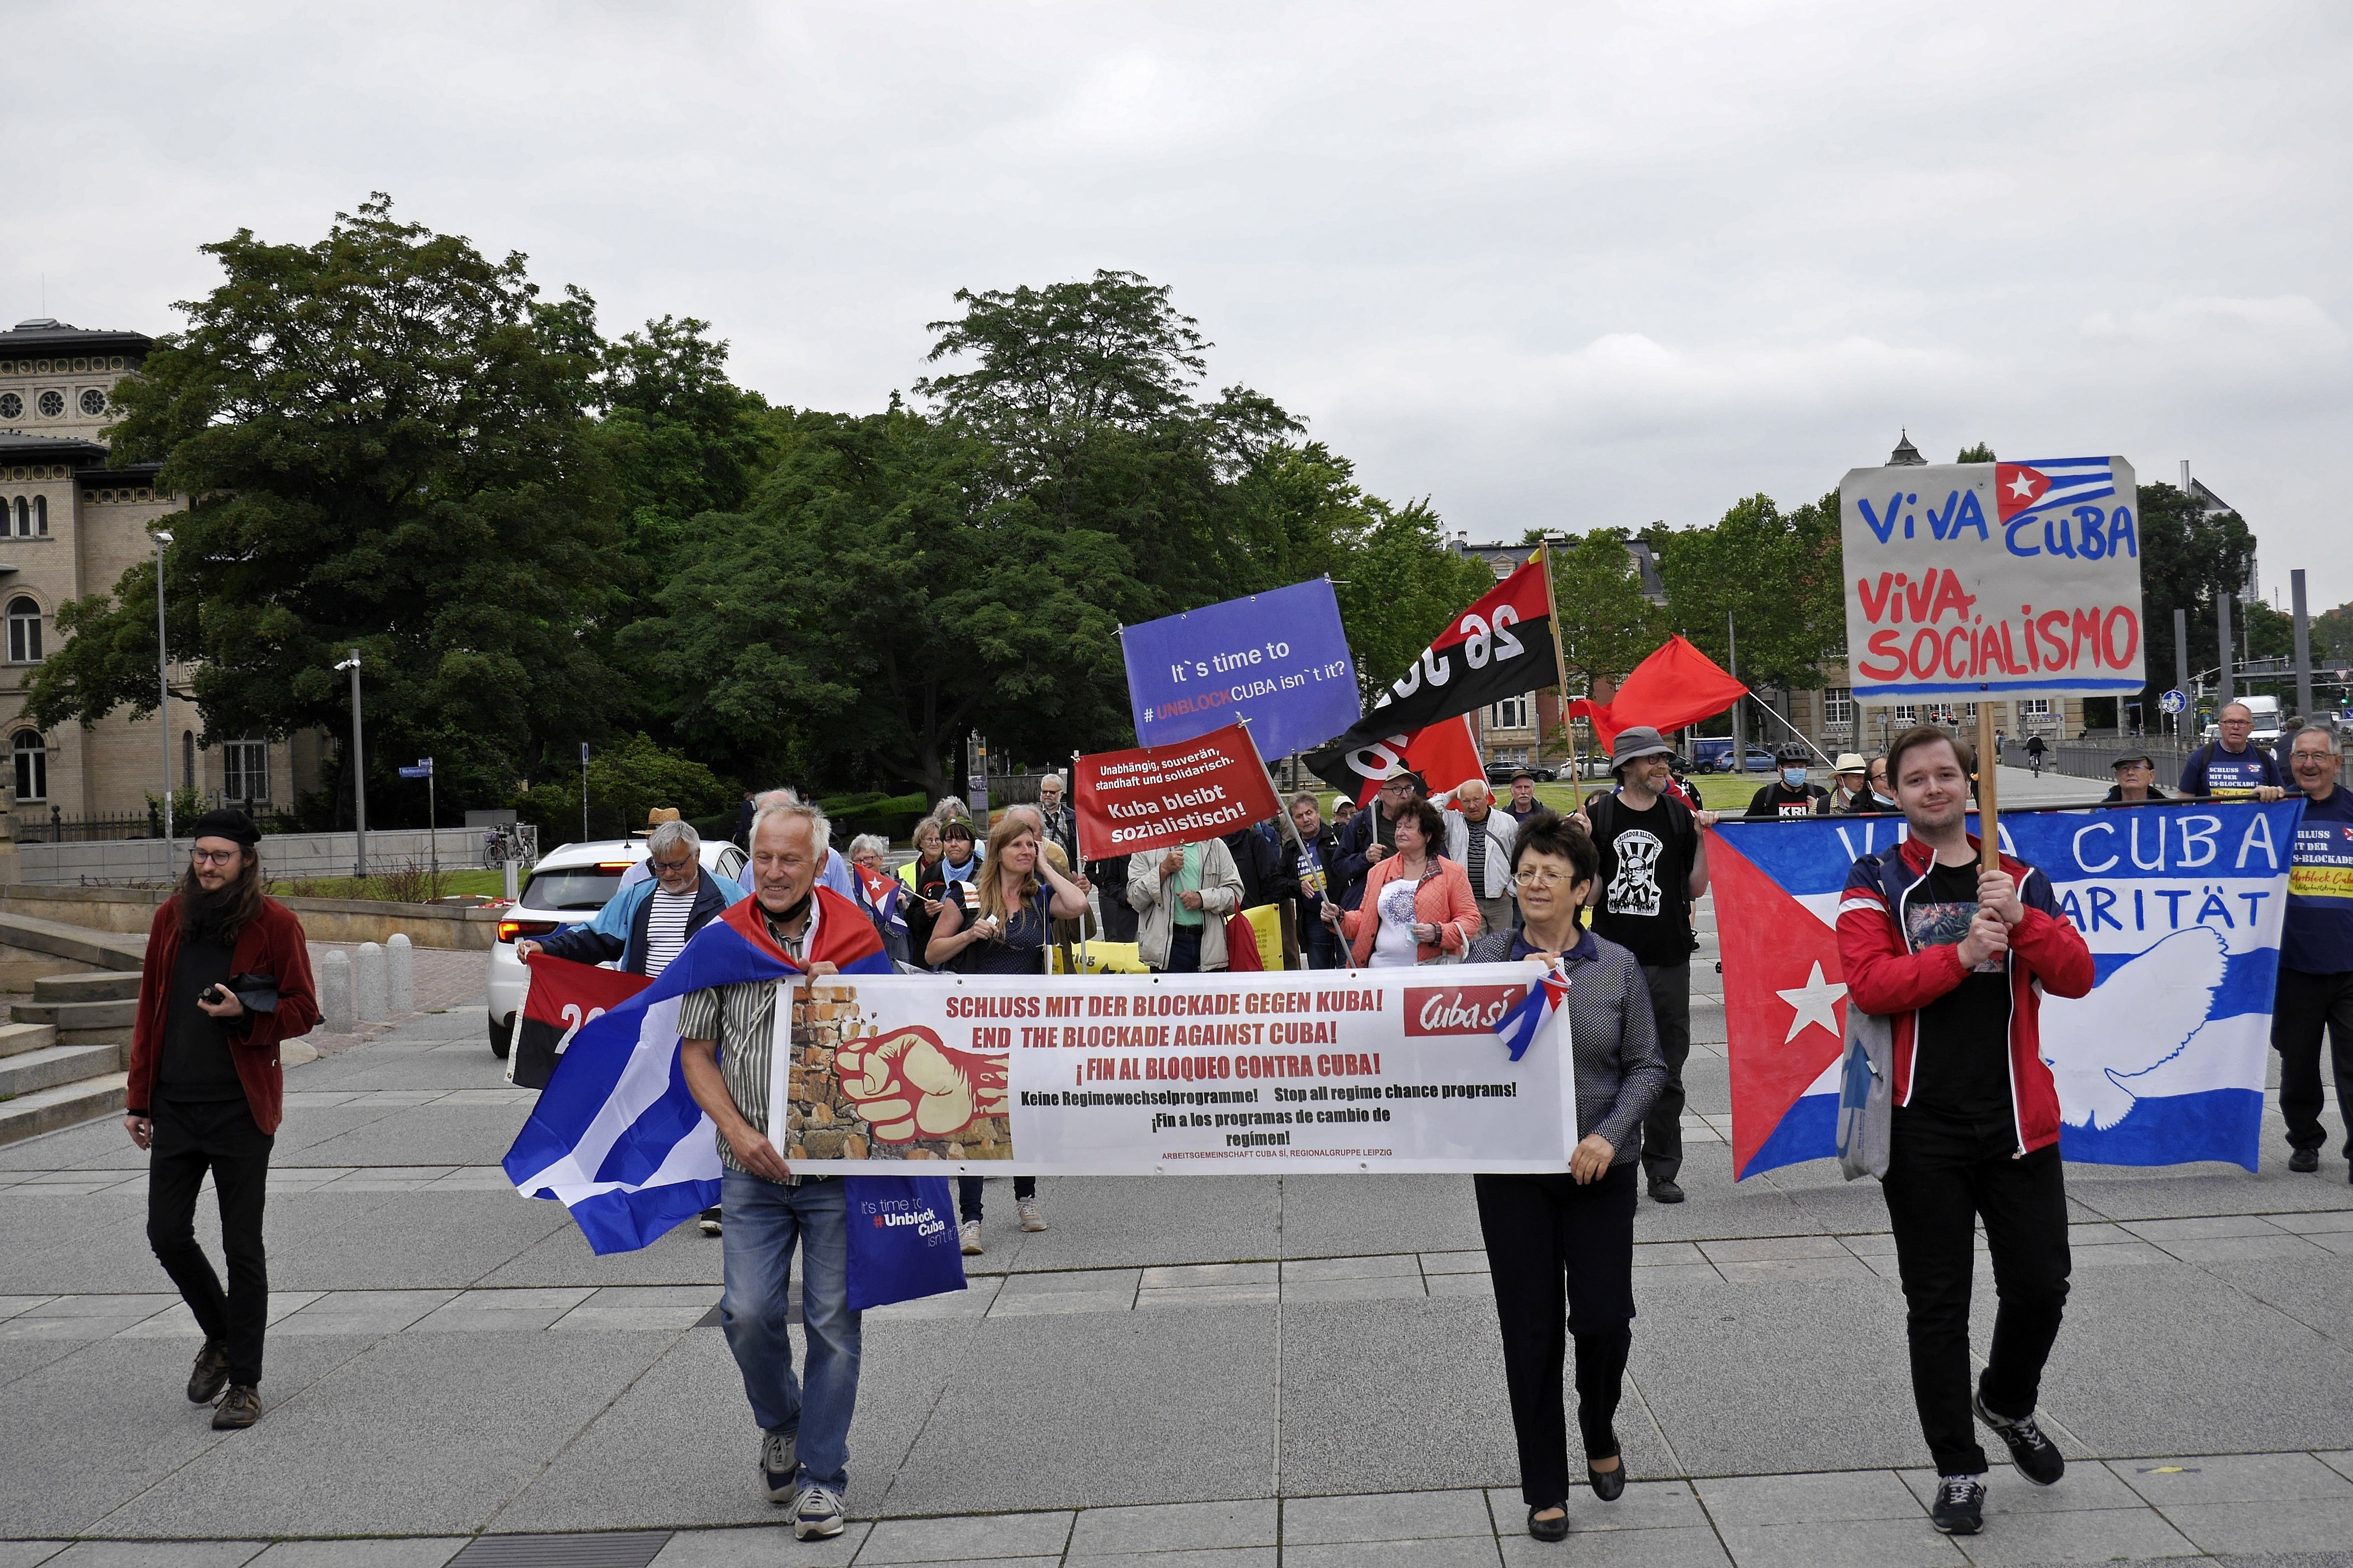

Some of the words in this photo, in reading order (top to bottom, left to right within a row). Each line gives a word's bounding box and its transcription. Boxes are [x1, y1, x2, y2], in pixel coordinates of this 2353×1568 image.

[1212, 648, 1263, 675] time
[1266, 641, 1290, 661] to
[1324, 660, 1345, 679] it?
[1095, 773, 1140, 792] standhaft
[1143, 770, 1163, 785] und
[1165, 756, 1235, 783] solidarisch.
[1099, 759, 1160, 778] Unabhängig,
[1162, 746, 1220, 771] souverän,
[1107, 794, 1158, 820] Kuba
[1162, 783, 1227, 812] bleibt
[1110, 801, 1247, 844] sozialistisch!
[2073, 813, 2278, 872] CUBA
[946, 996, 1040, 1018] SCHLUSS
[1045, 995, 1083, 1018] MIT
[1088, 994, 1128, 1017] DER
[1133, 993, 1240, 1017] BLOCKADE
[1245, 992, 1312, 1015] GEGEN
[1316, 989, 1383, 1012] KUBA!
[1419, 992, 1479, 1031] Cuba
[555, 1004, 606, 1054] 2
[972, 1026, 1011, 1049] END
[1021, 1026, 1059, 1048] THE
[1063, 1025, 1168, 1048] BLOCKADE
[1174, 1022, 1267, 1046] AGAINST
[1270, 1021, 1337, 1045] CUBA!
[1119, 1057, 1141, 1080] AL
[1145, 1056, 1230, 1083] BLOQUEO
[1235, 1054, 1314, 1078] CONTRA
[1317, 1053, 1381, 1076] CUBA!
[1021, 1091, 1059, 1106] Keine
[1063, 1088, 1258, 1108] Regimewechselprogramme!
[1274, 1086, 1308, 1104] Stop
[1310, 1085, 1328, 1100] all
[1331, 1086, 1382, 1102] regime
[1385, 1084, 1439, 1099] chance
[1441, 1081, 1517, 1100] programs!
[1151, 1113, 1176, 1133] ¡Fin
[1178, 1116, 1187, 1127] a
[1189, 1111, 1213, 1126] los
[1215, 1111, 1293, 1129] programas
[1295, 1109, 1314, 1125] de
[1316, 1107, 1369, 1124] cambio
[1372, 1106, 1391, 1122] de
[1162, 1150, 1253, 1160] ARBEITSGEMEINSCHAFT
[1256, 1150, 1277, 1158] CUBA
[1290, 1149, 1361, 1158] REGIONALGRUPPE
[1363, 1148, 1392, 1157] LEIPZIG
[861, 1201, 876, 1214] It's
[880, 1199, 909, 1212] time
[918, 1220, 945, 1237] Cuba
